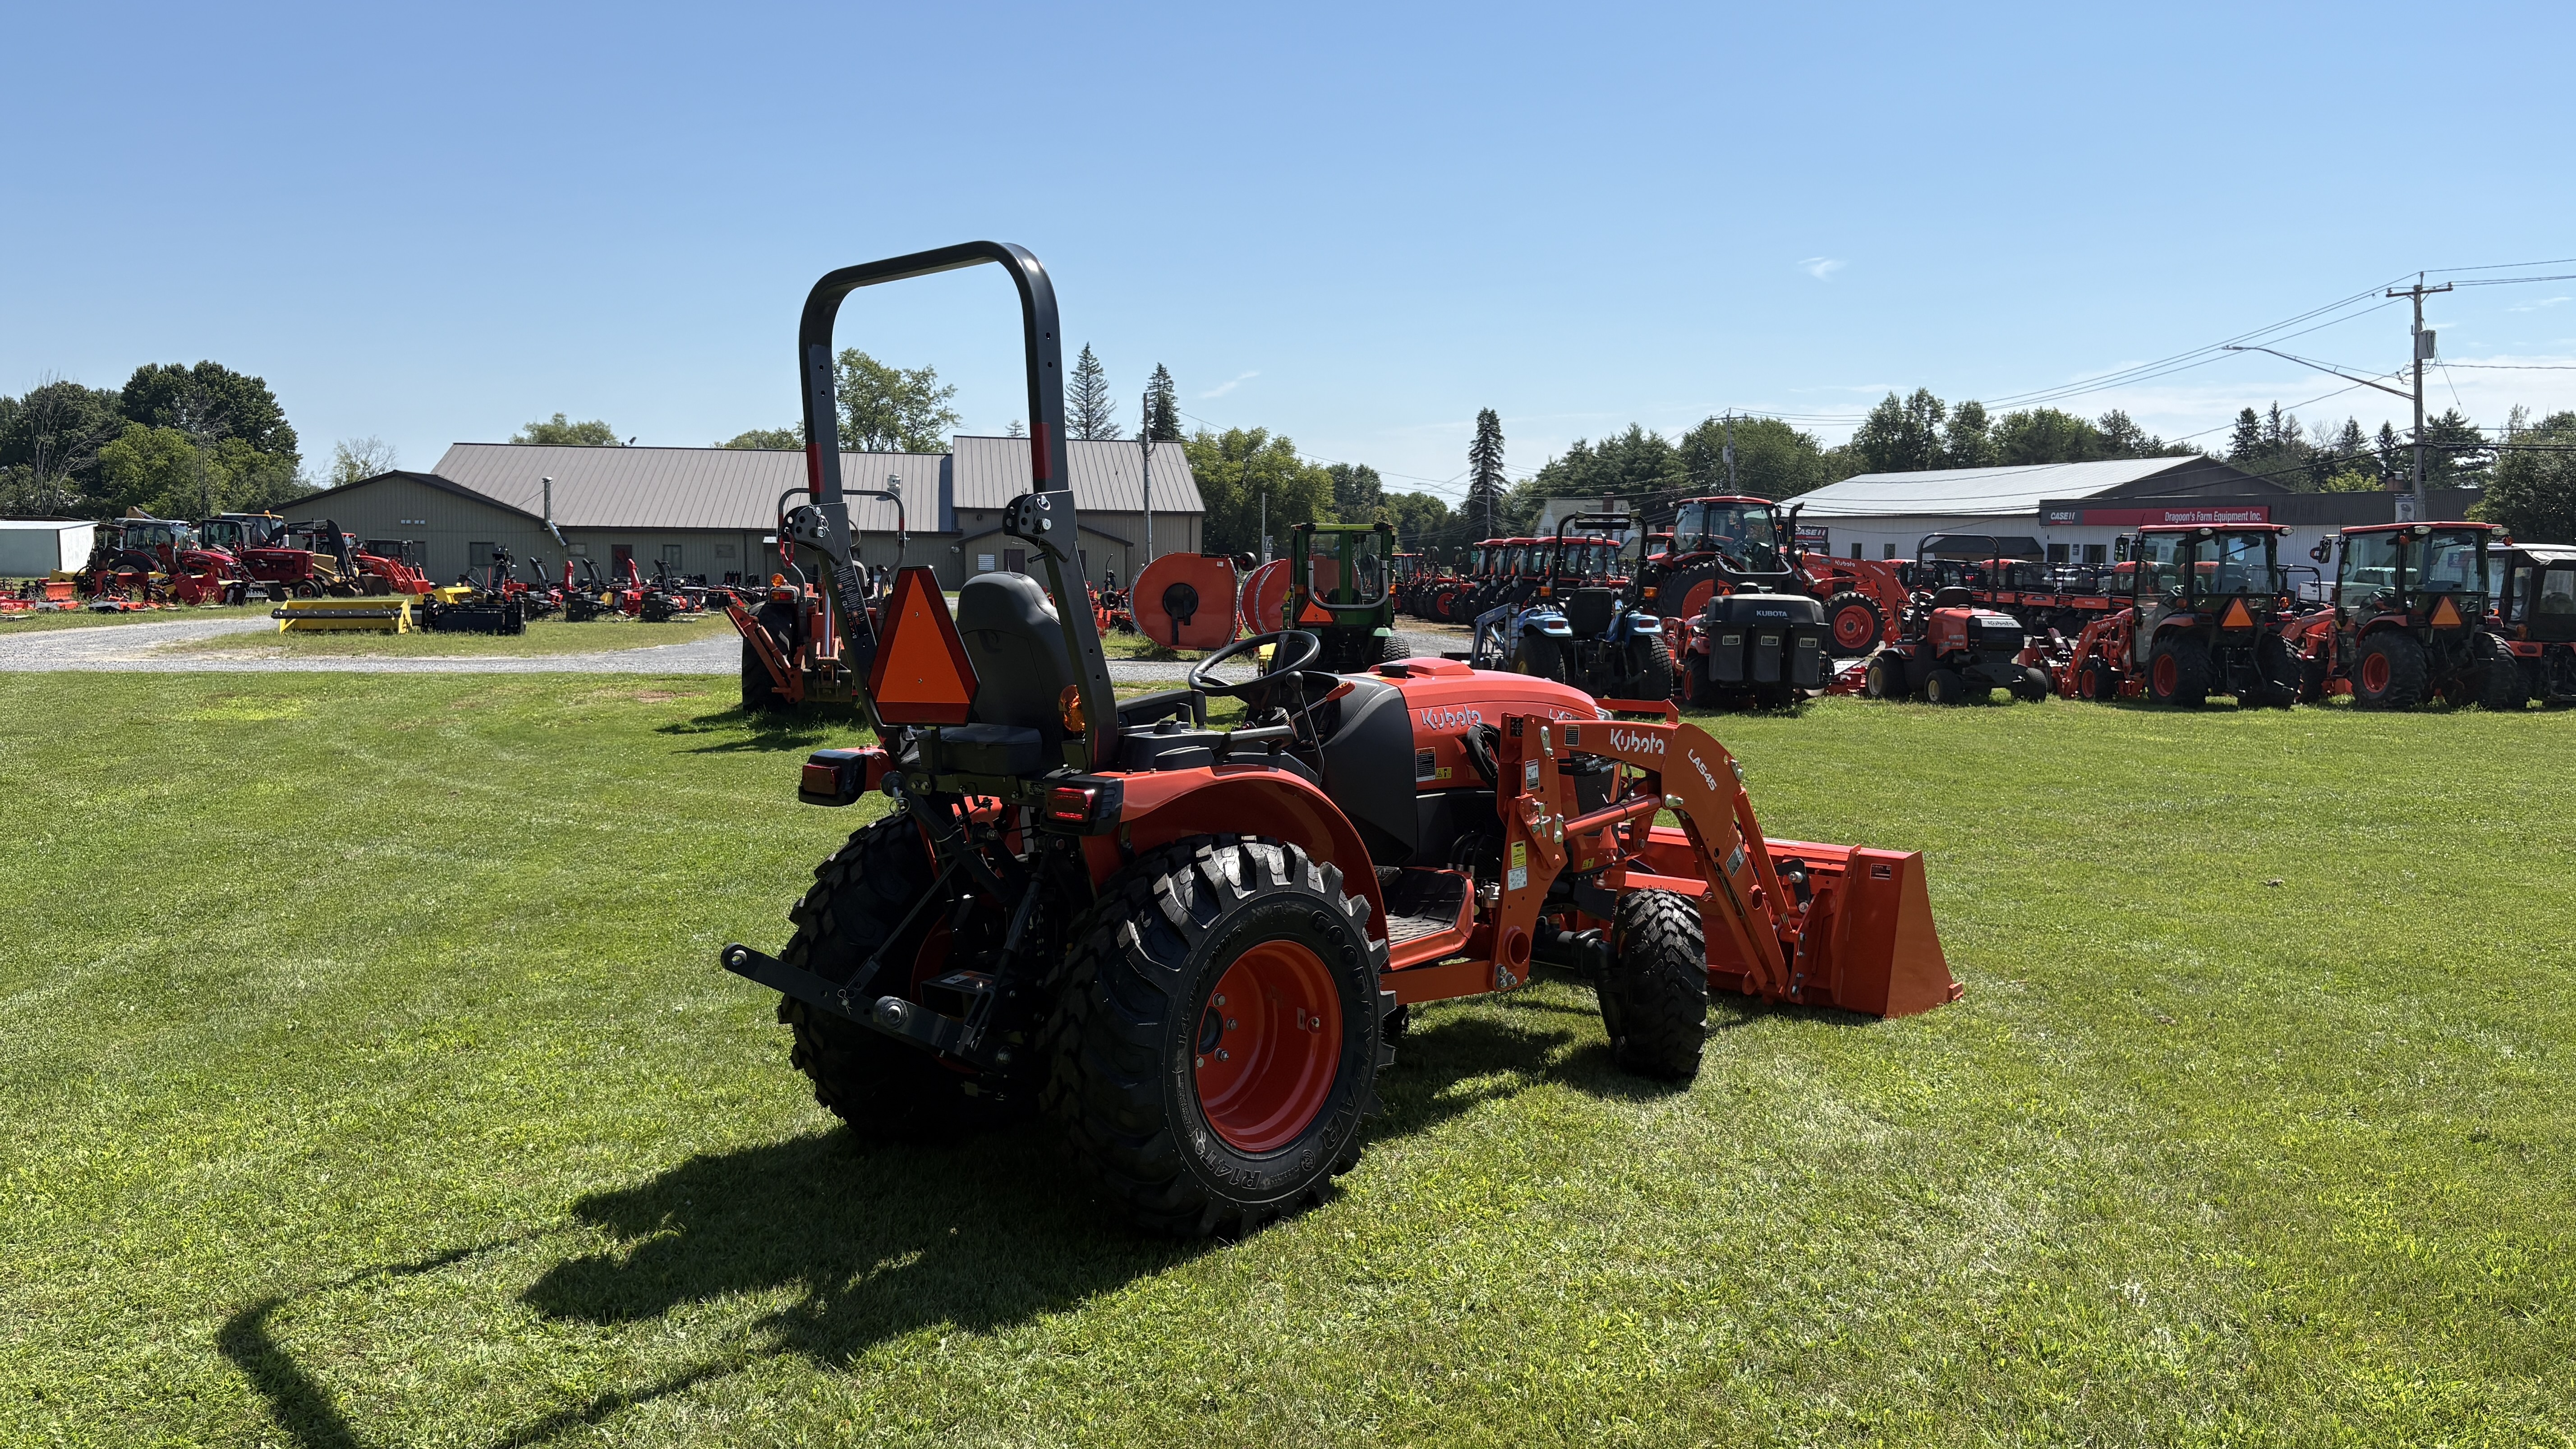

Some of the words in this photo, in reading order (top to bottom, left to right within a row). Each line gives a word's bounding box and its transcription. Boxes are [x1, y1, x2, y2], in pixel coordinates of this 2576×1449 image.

[2051, 512, 2069, 520] CASE
[2165, 511, 2195, 524] Dragoon's
[2197, 511, 2212, 521] Farm
[2214, 511, 2248, 523] Equipment
[2250, 511, 2262, 521] Inc.
[1420, 705, 1482, 729] Kubota
[1610, 728, 1665, 754] Kubota
[1688, 748, 1717, 791] LA545
[1311, 910, 1373, 1150] GOODYEAR
[1200, 1150, 1262, 1190] R14T
